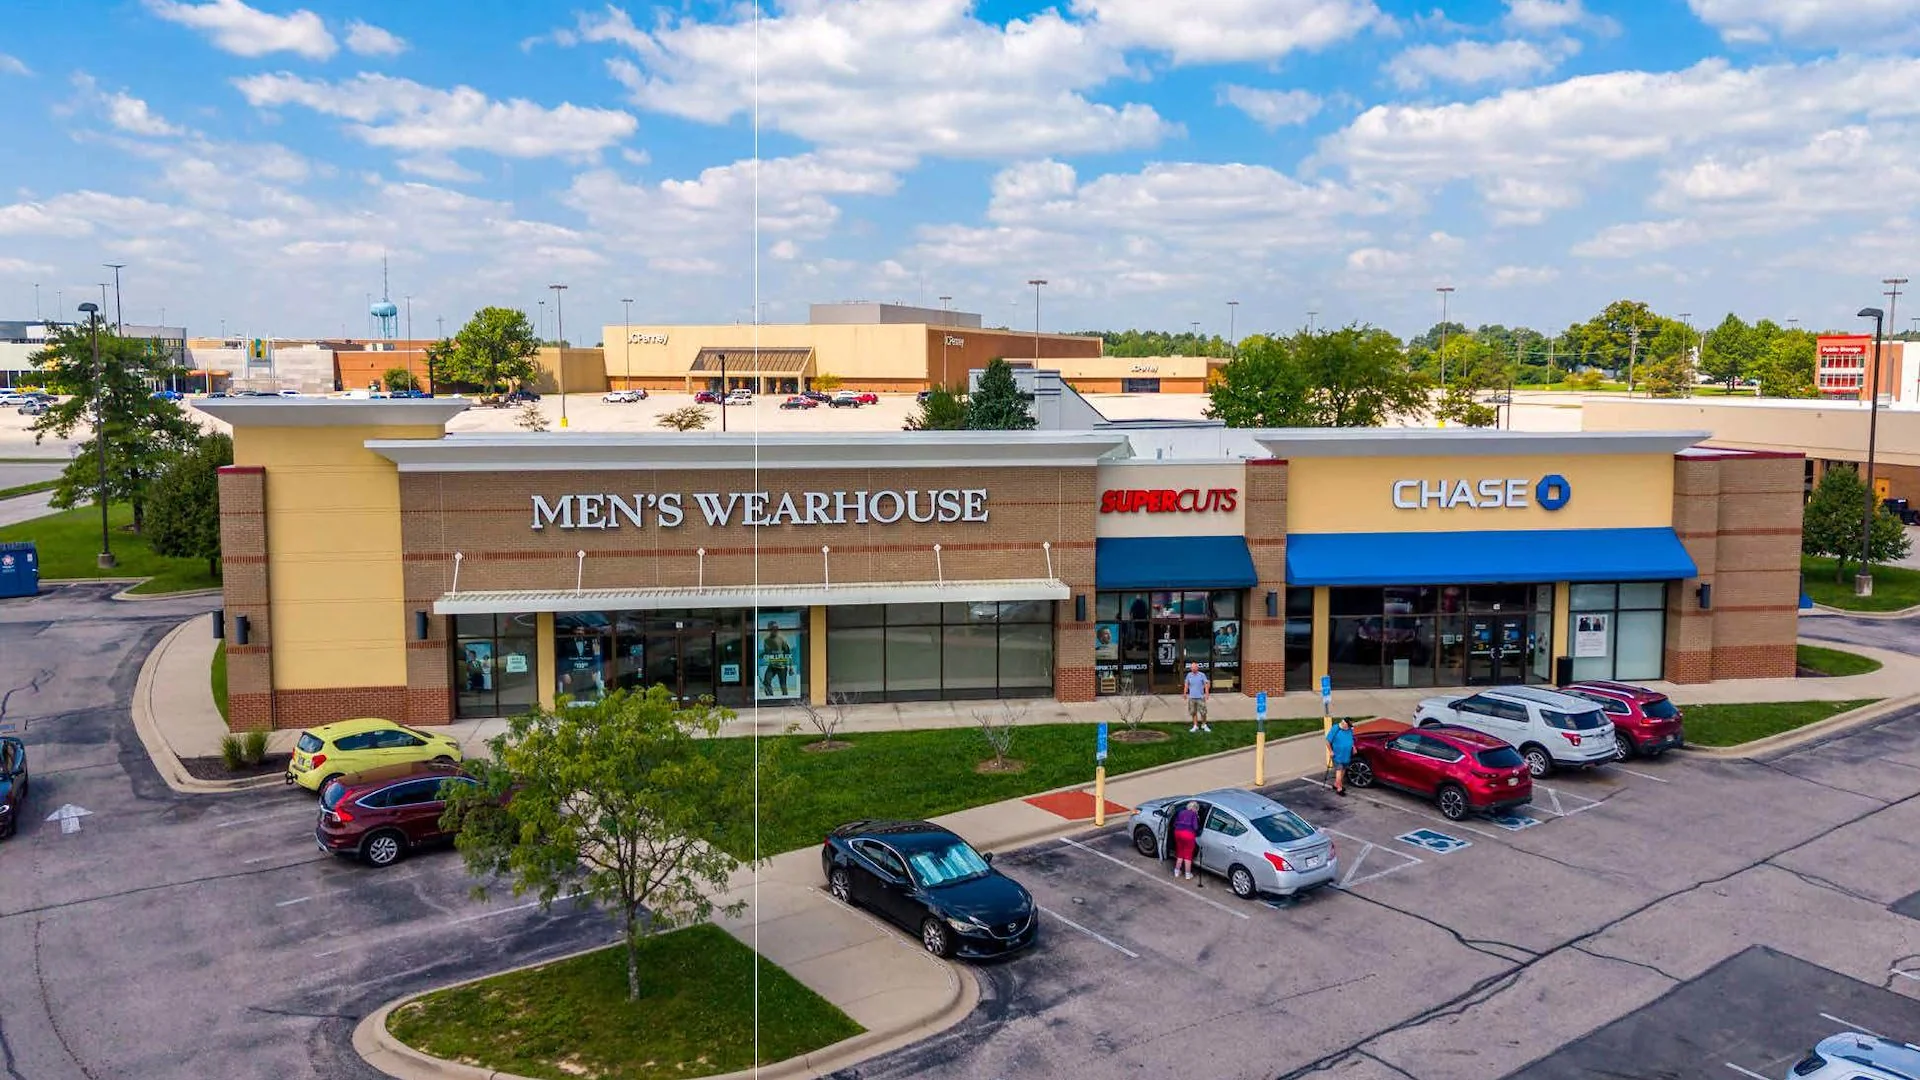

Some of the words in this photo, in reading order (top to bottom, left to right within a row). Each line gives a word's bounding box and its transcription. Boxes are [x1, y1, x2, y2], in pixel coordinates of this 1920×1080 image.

[531, 493, 683, 529] MEN'S
[693, 488, 989, 527] WEARHOUSE
[1100, 488, 1238, 513] SUPERCUTS
[1392, 478, 1530, 510] CHASE
